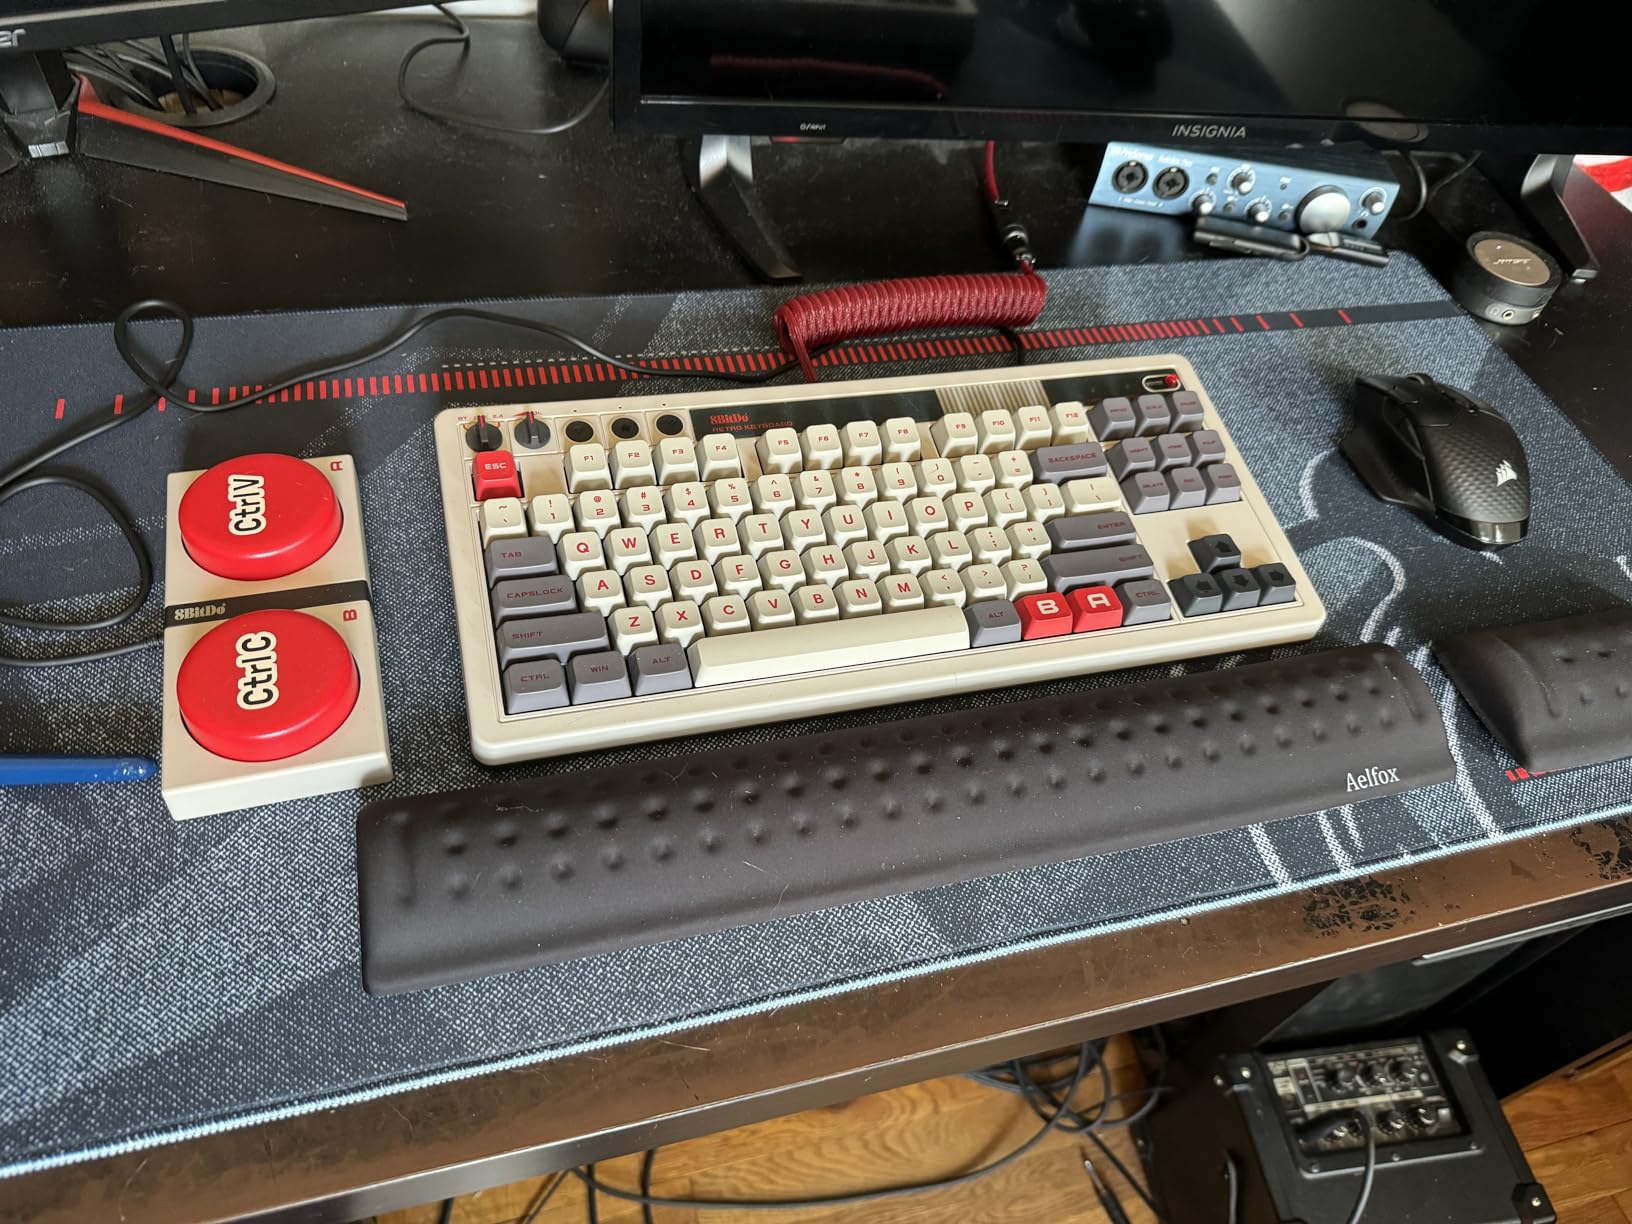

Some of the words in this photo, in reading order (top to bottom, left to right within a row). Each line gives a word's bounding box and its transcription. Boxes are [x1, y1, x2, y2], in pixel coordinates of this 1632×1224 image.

[1171, 124, 1247, 138] INSIGNIA
[710, 413, 749, 425] 8BitDo
[713, 424, 740, 433] RETRO
[743, 421, 793, 431] KEYBOARD
[1047, 452, 1097, 464] BACKSPACE
[330, 460, 344, 472] A
[485, 462, 507, 470] ESC
[898, 478, 905, 486] 9
[773, 490, 781, 498] 6
[687, 499, 696, 507] 4
[965, 501, 973, 511] P
[595, 508, 604, 516] 2
[925, 505, 936, 516] O
[801, 518, 811, 529] Y
[843, 513, 854, 525] U
[759, 522, 768, 535] T
[1097, 520, 1126, 530] ENTER
[671, 533, 680, 545] E
[714, 528, 726, 540] R
[576, 543, 590, 554] Q
[622, 537, 637, 549] W
[948, 540, 957, 550] L
[501, 551, 522, 559] TAB
[907, 544, 918, 555] K
[822, 554, 835, 565] H
[867, 550, 875, 561] J
[735, 564, 744, 575] F
[779, 560, 791, 571] G
[644, 575, 656, 586] S
[690, 570, 702, 581] D
[598, 580, 609, 591] A
[897, 582, 911, 593] M
[506, 587, 563, 598] CAPSLOCK
[855, 588, 868, 599] N
[768, 599, 779, 609] V
[813, 594, 825, 605] B
[1087, 593, 1111, 608] A
[174, 604, 226, 620] 8BitDo
[723, 605, 735, 616] C
[1036, 599, 1060, 615] B
[344, 609, 358, 622] B
[676, 611, 688, 621] X
[988, 610, 1005, 619] ALT
[629, 616, 640, 628] Z
[511, 630, 543, 640] SHIFT
[590, 664, 608, 673] WIN
[520, 673, 550, 683] CTRL
[1345, 766, 1401, 792] Aelfox
